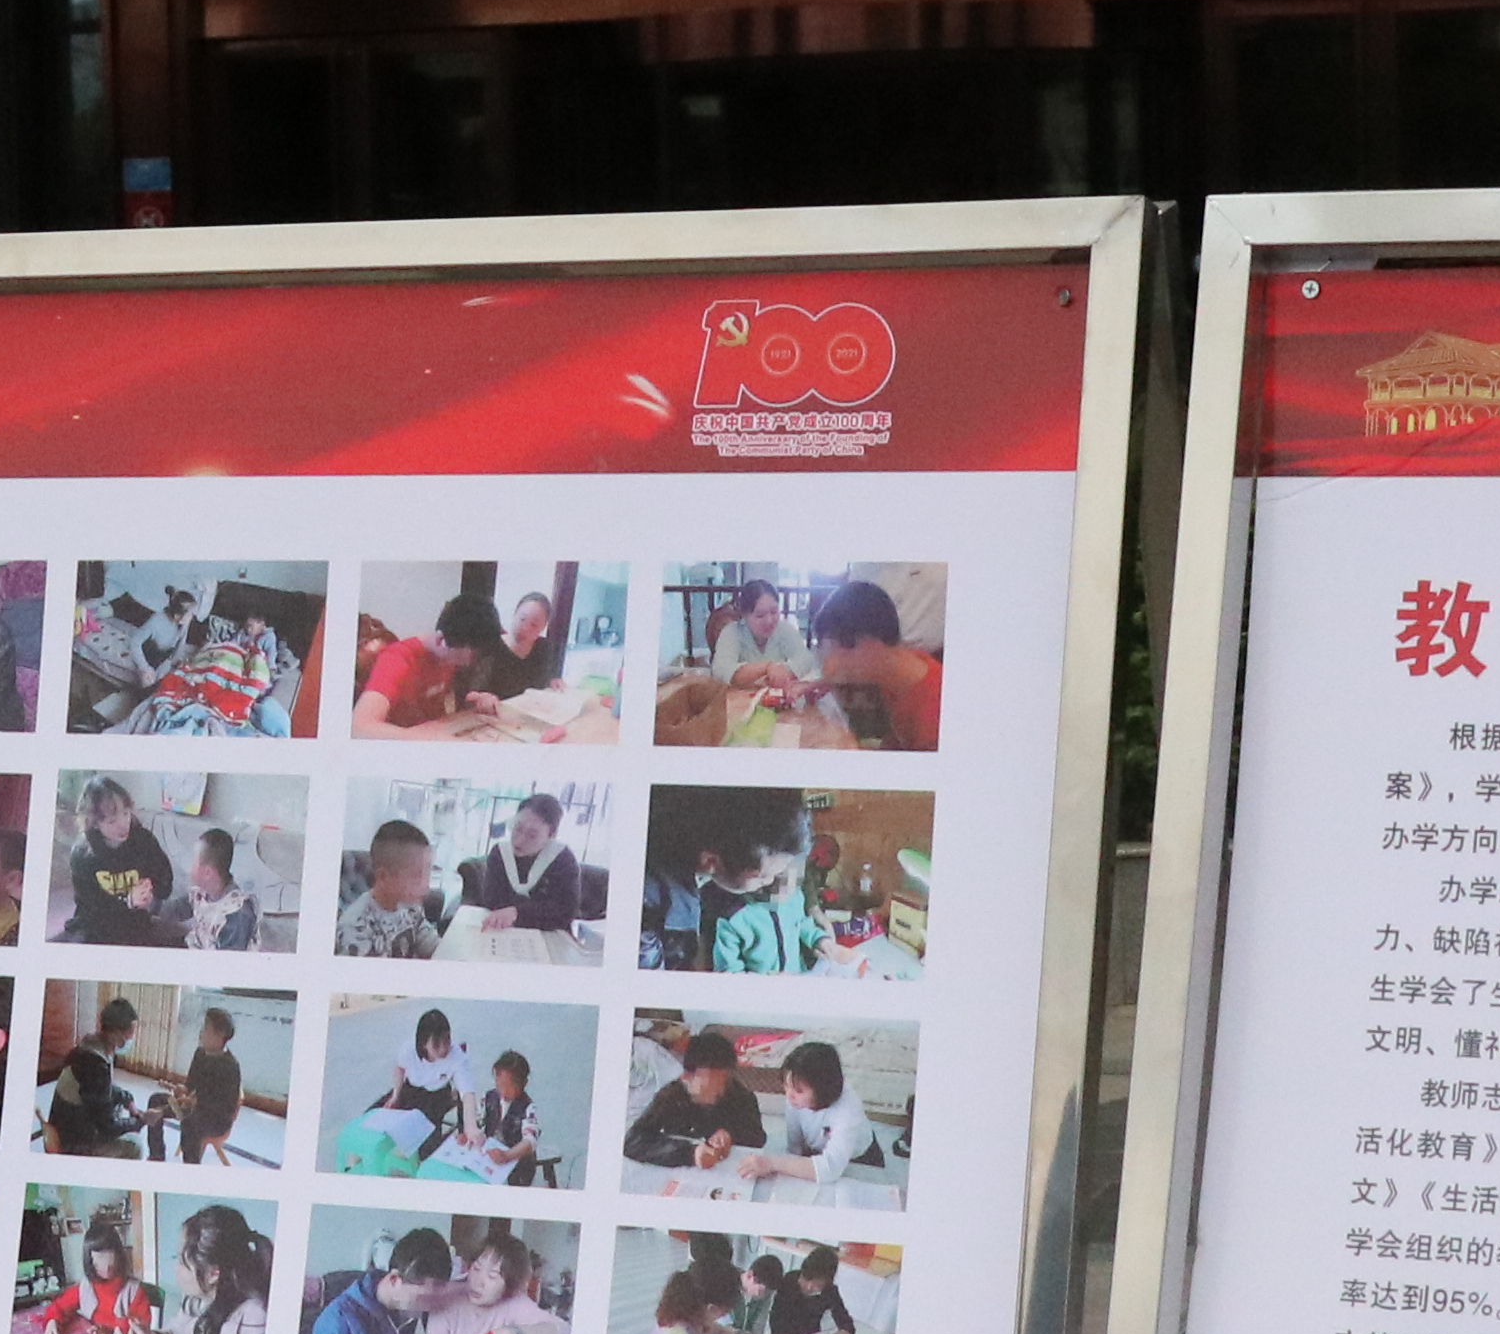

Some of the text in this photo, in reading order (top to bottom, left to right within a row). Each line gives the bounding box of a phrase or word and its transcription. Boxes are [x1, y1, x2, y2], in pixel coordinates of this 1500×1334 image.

[692, 411, 892, 431] 庆祝中国共产党成立100周年
